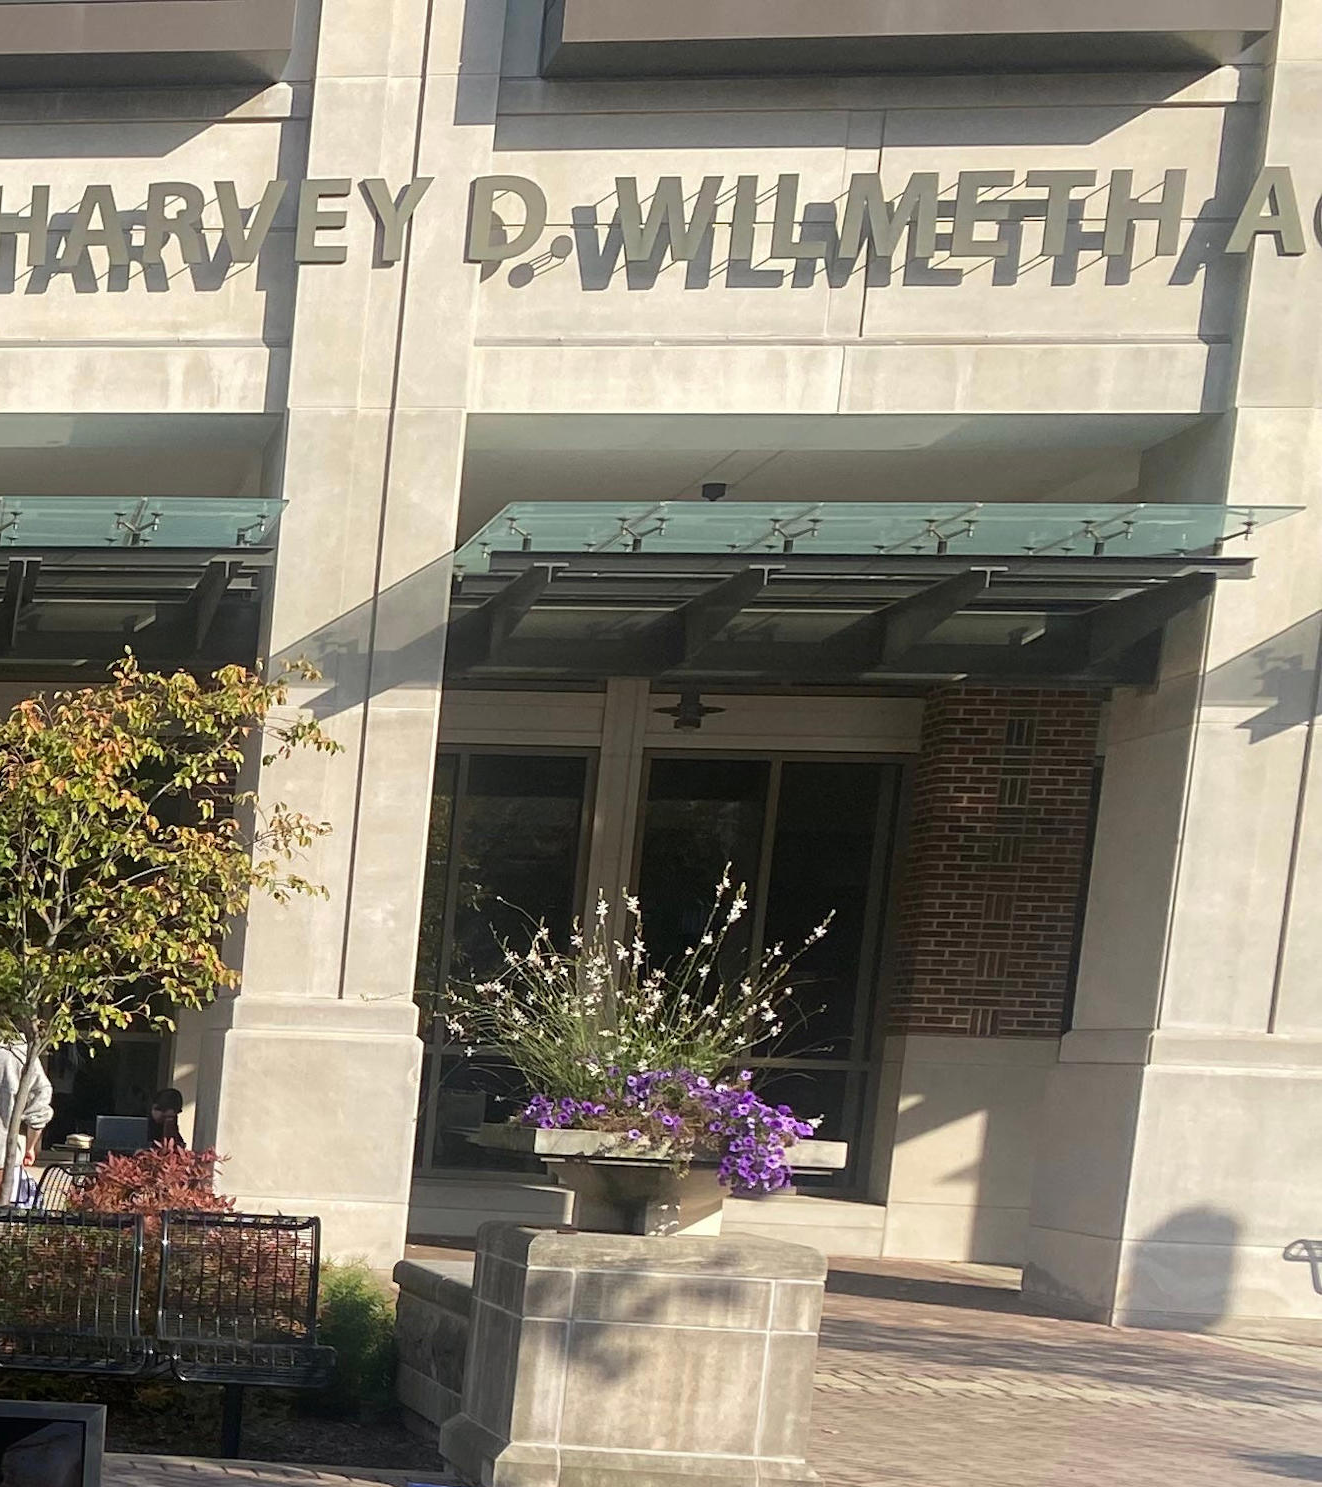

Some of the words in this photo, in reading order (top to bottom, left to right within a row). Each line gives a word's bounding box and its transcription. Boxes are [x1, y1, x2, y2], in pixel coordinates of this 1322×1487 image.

[468, 174, 573, 266] D.
[613, 166, 1189, 264] WILMETH
[1224, 165, 1322, 258] A
